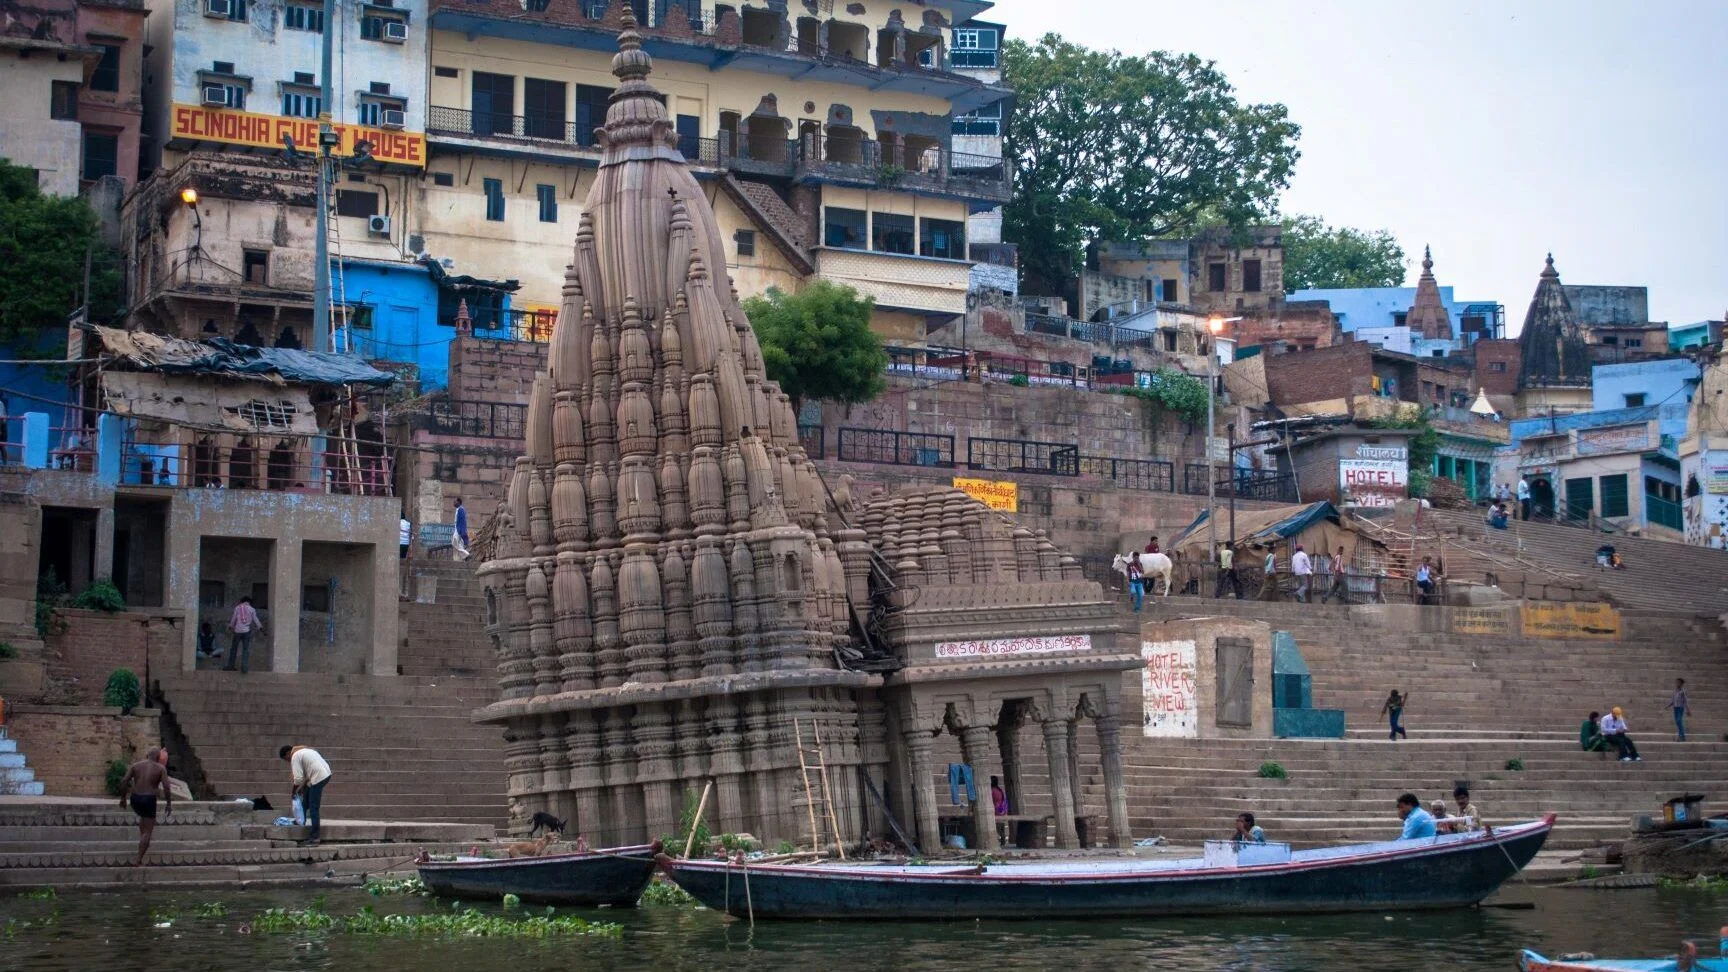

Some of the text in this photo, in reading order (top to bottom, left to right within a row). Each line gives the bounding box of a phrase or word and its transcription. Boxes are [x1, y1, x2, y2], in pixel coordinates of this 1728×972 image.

[177, 108, 270, 143] SCINDHIA
[276, 120, 346, 151] GUET
[1345, 469, 1401, 485] HOTEL
[1145, 651, 1189, 670] HOTEL
[1150, 671, 1194, 693] RIVER
[1152, 692, 1185, 711] VIEW
